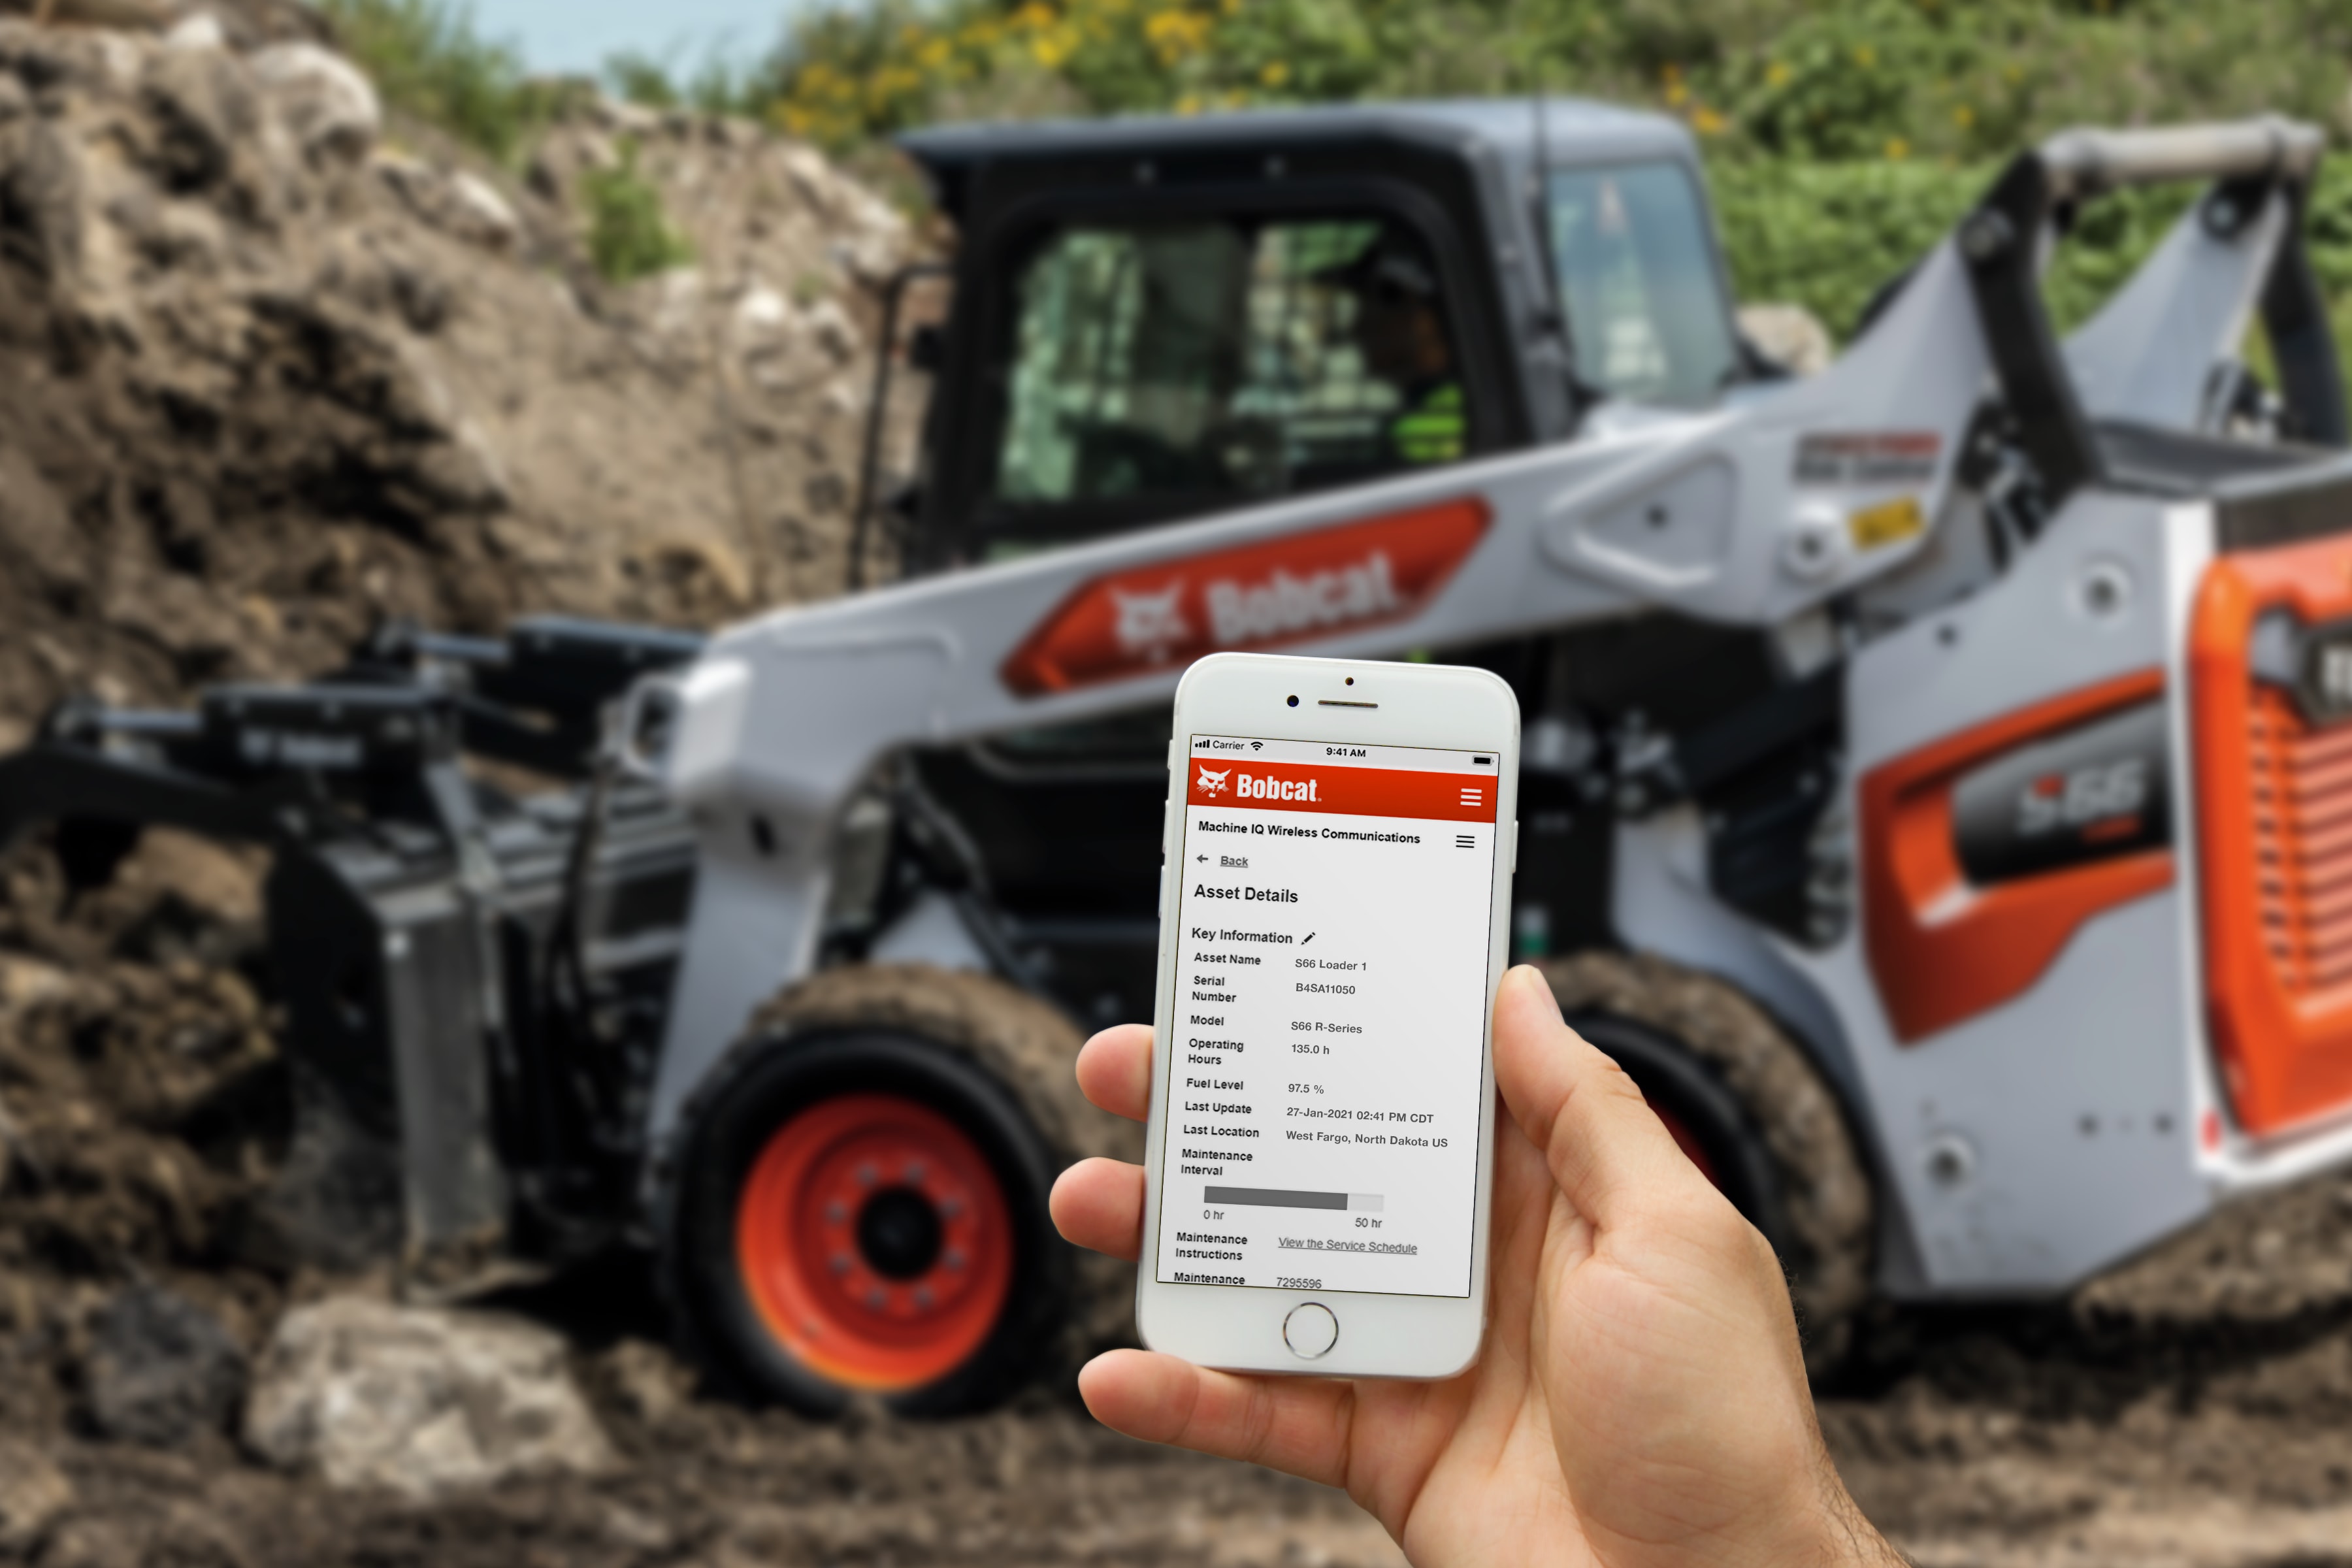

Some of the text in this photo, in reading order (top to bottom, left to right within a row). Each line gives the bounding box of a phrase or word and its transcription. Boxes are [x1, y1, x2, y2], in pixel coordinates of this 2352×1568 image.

[1207, 550, 1396, 643] Bobcat
[1213, 740, 1244, 749] Carrier
[1326, 747, 1347, 756] 9:41
[1237, 774, 1316, 802] Bobcat
[1199, 821, 1420, 843] Machine IQ Wireless Communications
[1220, 856, 1248, 868] Back
[1194, 885, 1298, 902] Asset Details
[1192, 928, 1292, 943] Key Information
[1194, 953, 1261, 965] Asset Name
[1296, 959, 1315, 968] S66
[1320, 960, 1358, 970] Loader
[1194, 975, 1224, 986] Serial
[1296, 983, 1355, 994] B4SA11050
[1192, 991, 1236, 1002] Number
[1190, 1015, 1224, 1025] Model
[1291, 1022, 1362, 1034] S66 R-Series
[1189, 1039, 1243, 1053] Operating
[1292, 1044, 1329, 1054] 135.0 h
[1188, 1054, 1221, 1064] Hours
[1187, 1078, 1243, 1090] Fuel Level
[1288, 1084, 1324, 1094] 97.5 %
[1185, 1102, 1251, 1115] Last Update
[1287, 1107, 1433, 1122] 27-Jan-2021 02:41 PM CDT
[1184, 1125, 1259, 1137] Last Location
[1286, 1131, 1447, 1147] West Fargo, North Dakota US
[1183, 1149, 1252, 1161] Maintenance
[1181, 1165, 1222, 1175] Interval
[1204, 1210, 1224, 1220] 0 hr
[1355, 1218, 1382, 1228] 50 hr
[1177, 1232, 1247, 1244] Maintenance
[1279, 1237, 1418, 1254] View the Service Schedule
[1176, 1249, 1242, 1260] Instructions
[1174, 1272, 1245, 1284] Maintenance
[1277, 1277, 1322, 1288] 7295596
